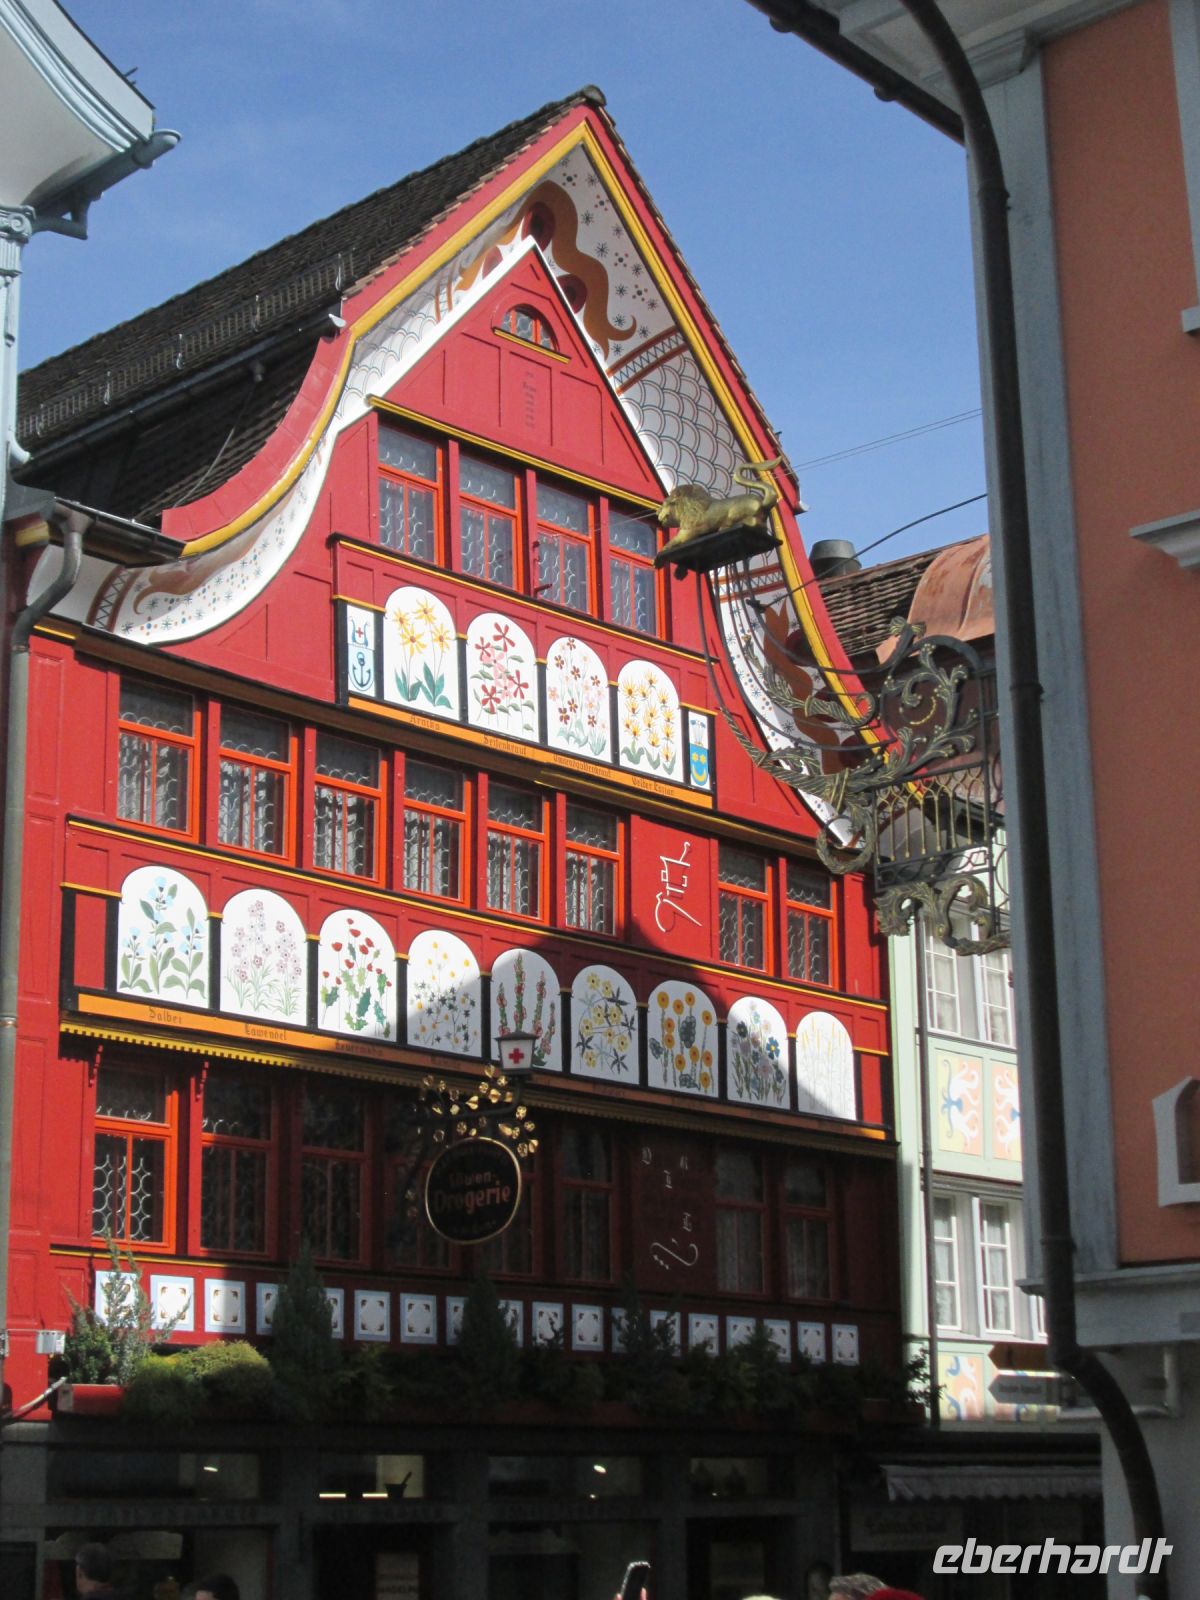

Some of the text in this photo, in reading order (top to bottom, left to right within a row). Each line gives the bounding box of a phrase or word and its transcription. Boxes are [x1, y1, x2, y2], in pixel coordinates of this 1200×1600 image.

[410, 714, 440, 731] Arnika
[148, 1006, 182, 1024] Salbei
[434, 1180, 511, 1214] Drogerie
